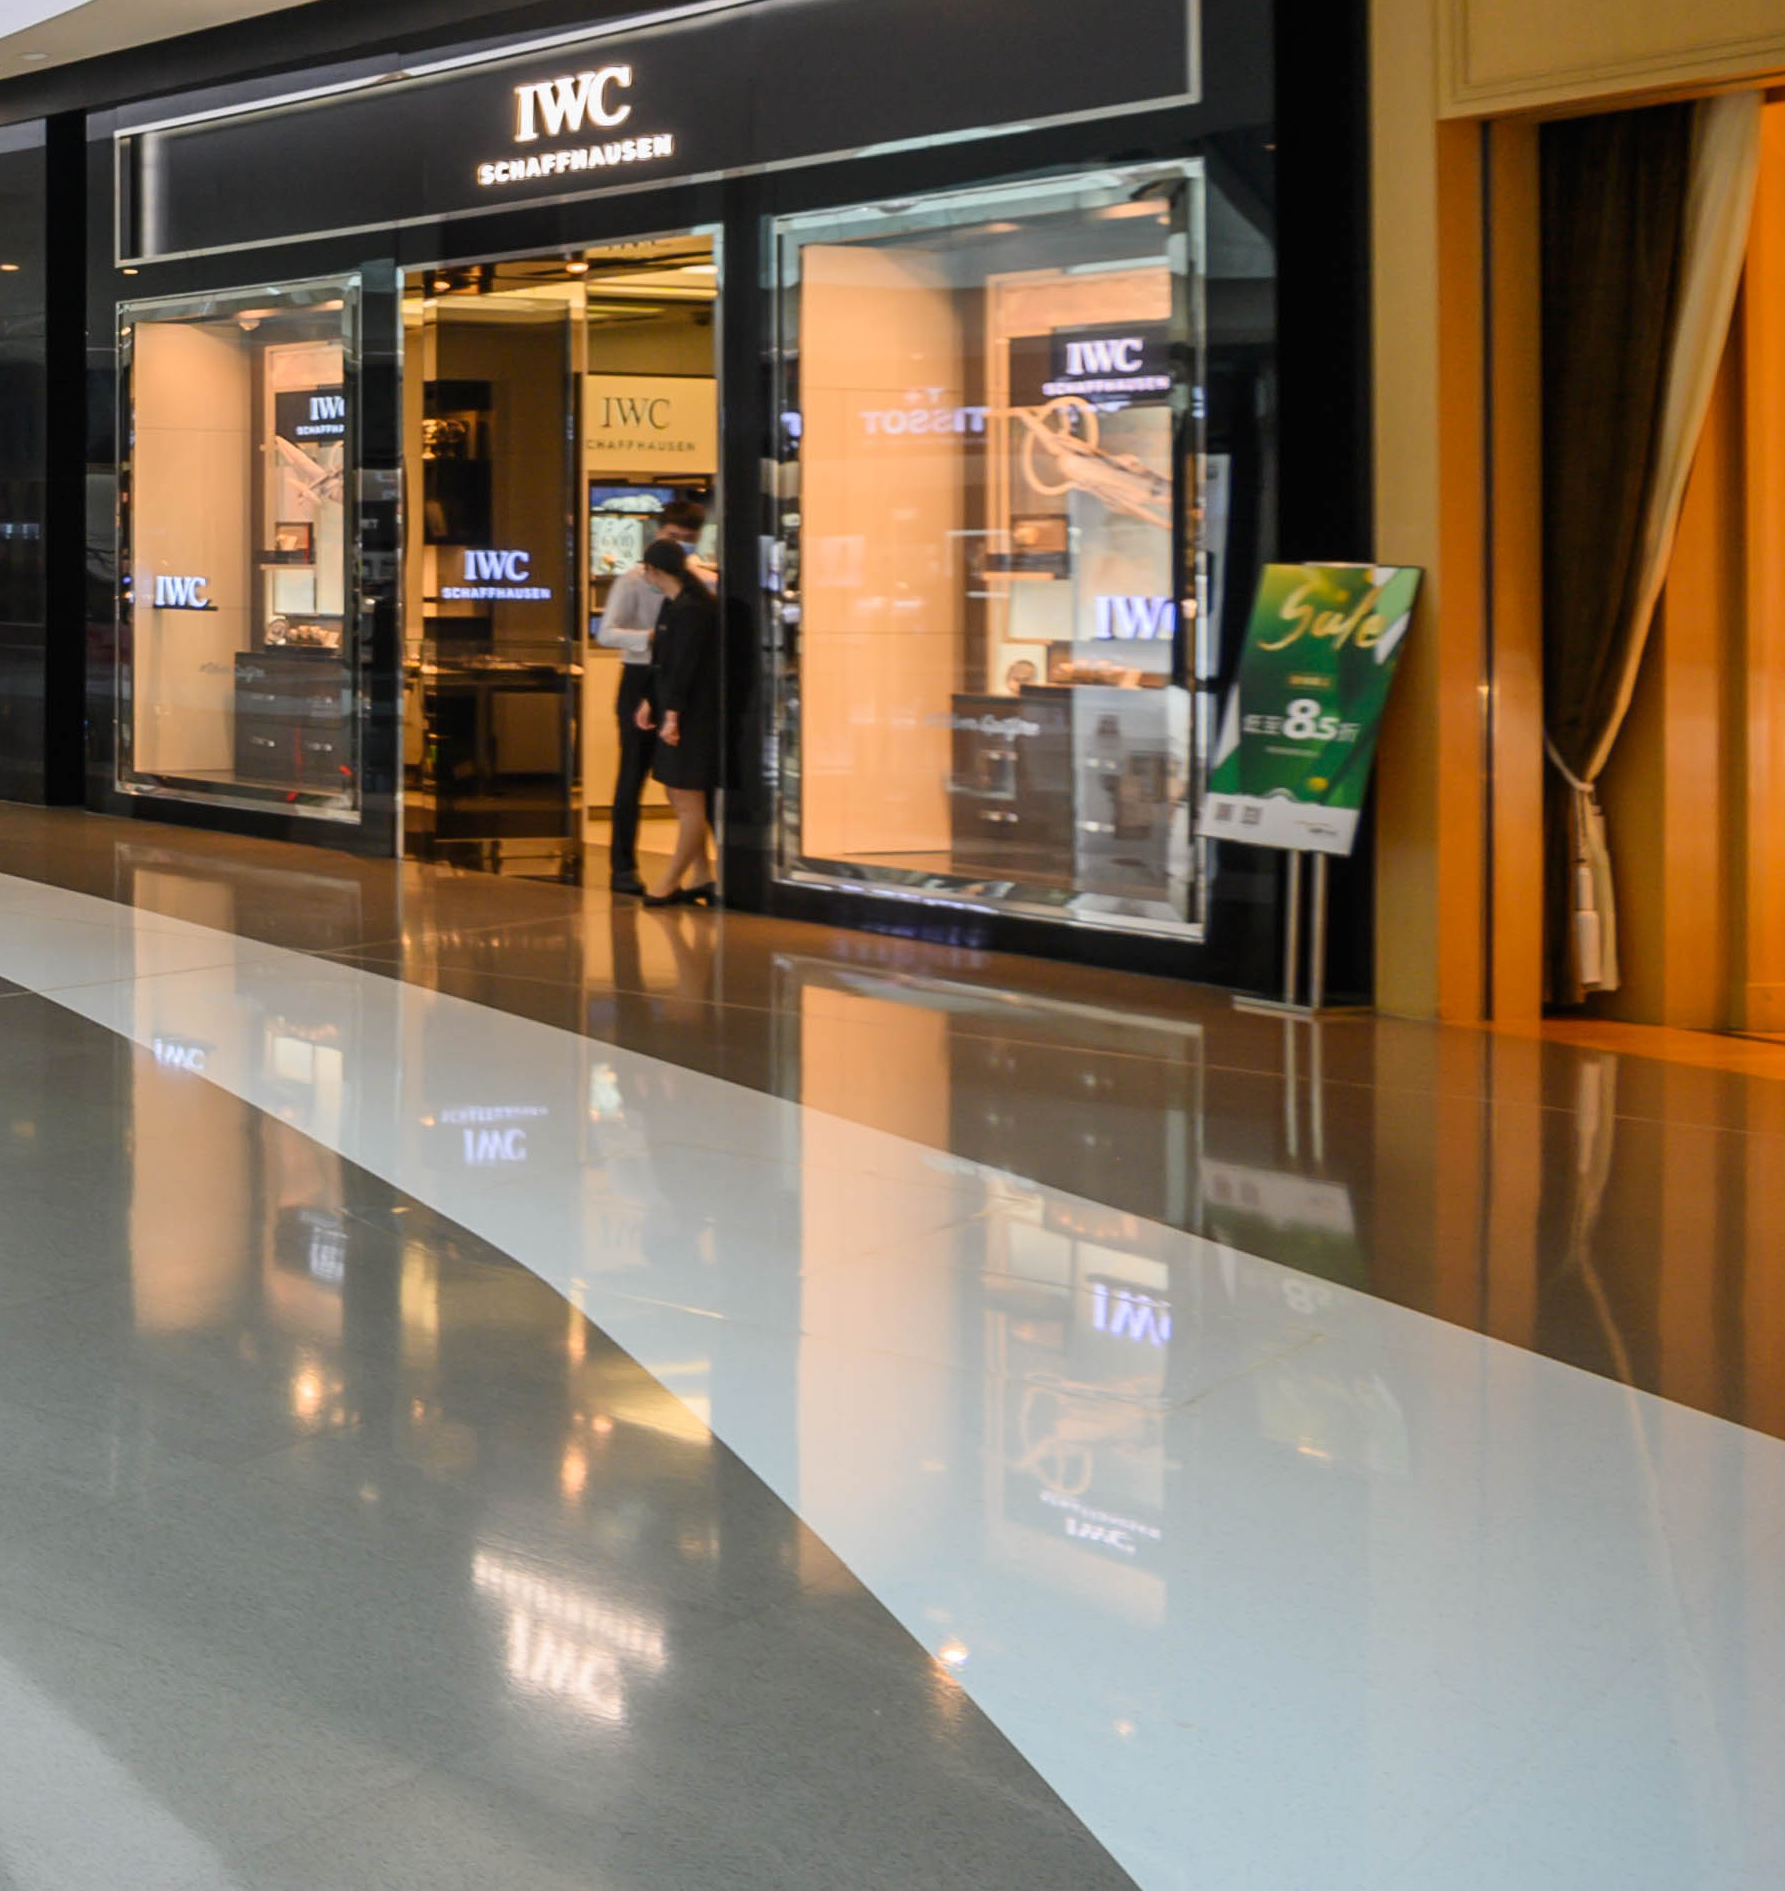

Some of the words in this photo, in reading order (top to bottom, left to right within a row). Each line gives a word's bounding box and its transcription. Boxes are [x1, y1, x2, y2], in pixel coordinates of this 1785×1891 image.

[514, 66, 632, 142] IWC
[478, 133, 674, 186] SCHAFFHAUSEN
[1065, 337, 1144, 375] IWC
[310, 396, 345, 420] IW
[602, 397, 671, 429] IWC
[464, 550, 530, 581] IWC
[155, 576, 208, 607] IWC
[442, 587, 552, 600] SCHAFFHAUSEN
[1257, 581, 1387, 651] Sale
